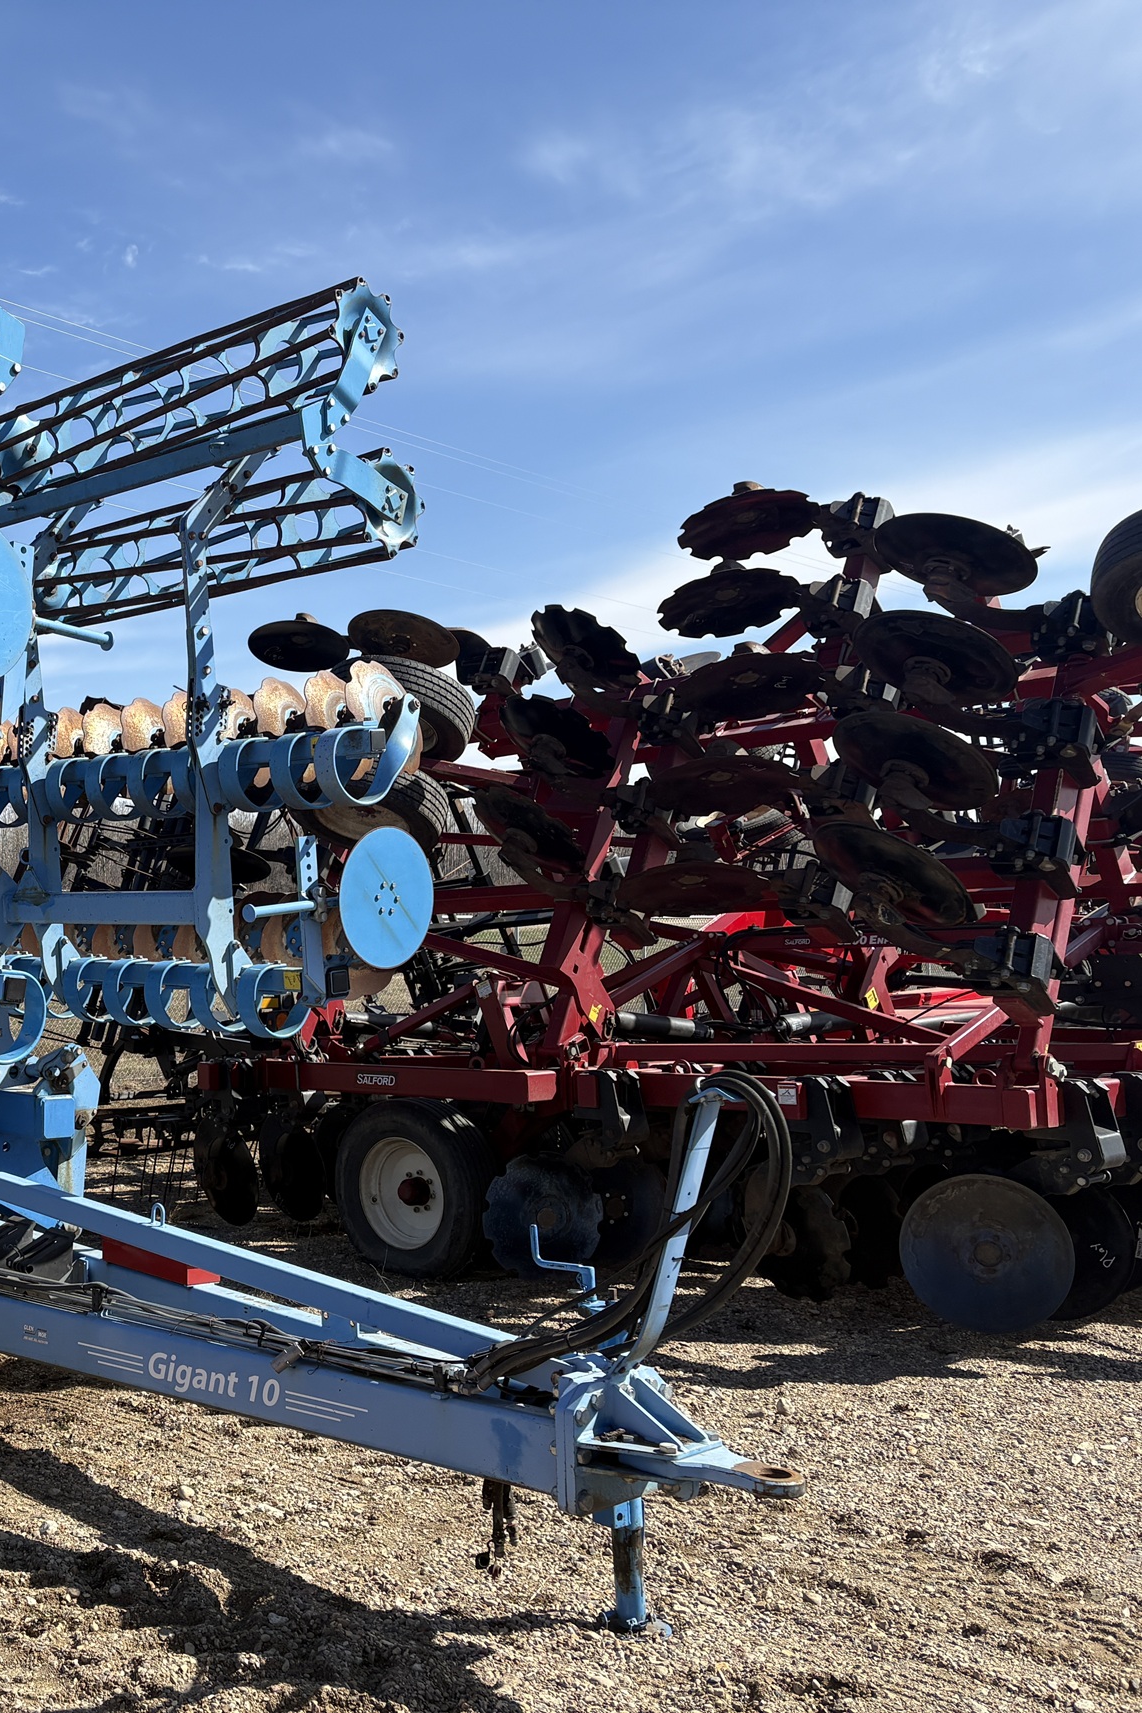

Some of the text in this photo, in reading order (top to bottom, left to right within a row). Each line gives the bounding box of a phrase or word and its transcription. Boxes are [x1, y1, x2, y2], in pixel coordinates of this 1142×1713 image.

[356, 1073, 396, 1086] SALFORD
[148, 1352, 280, 1407] Gigant 10
